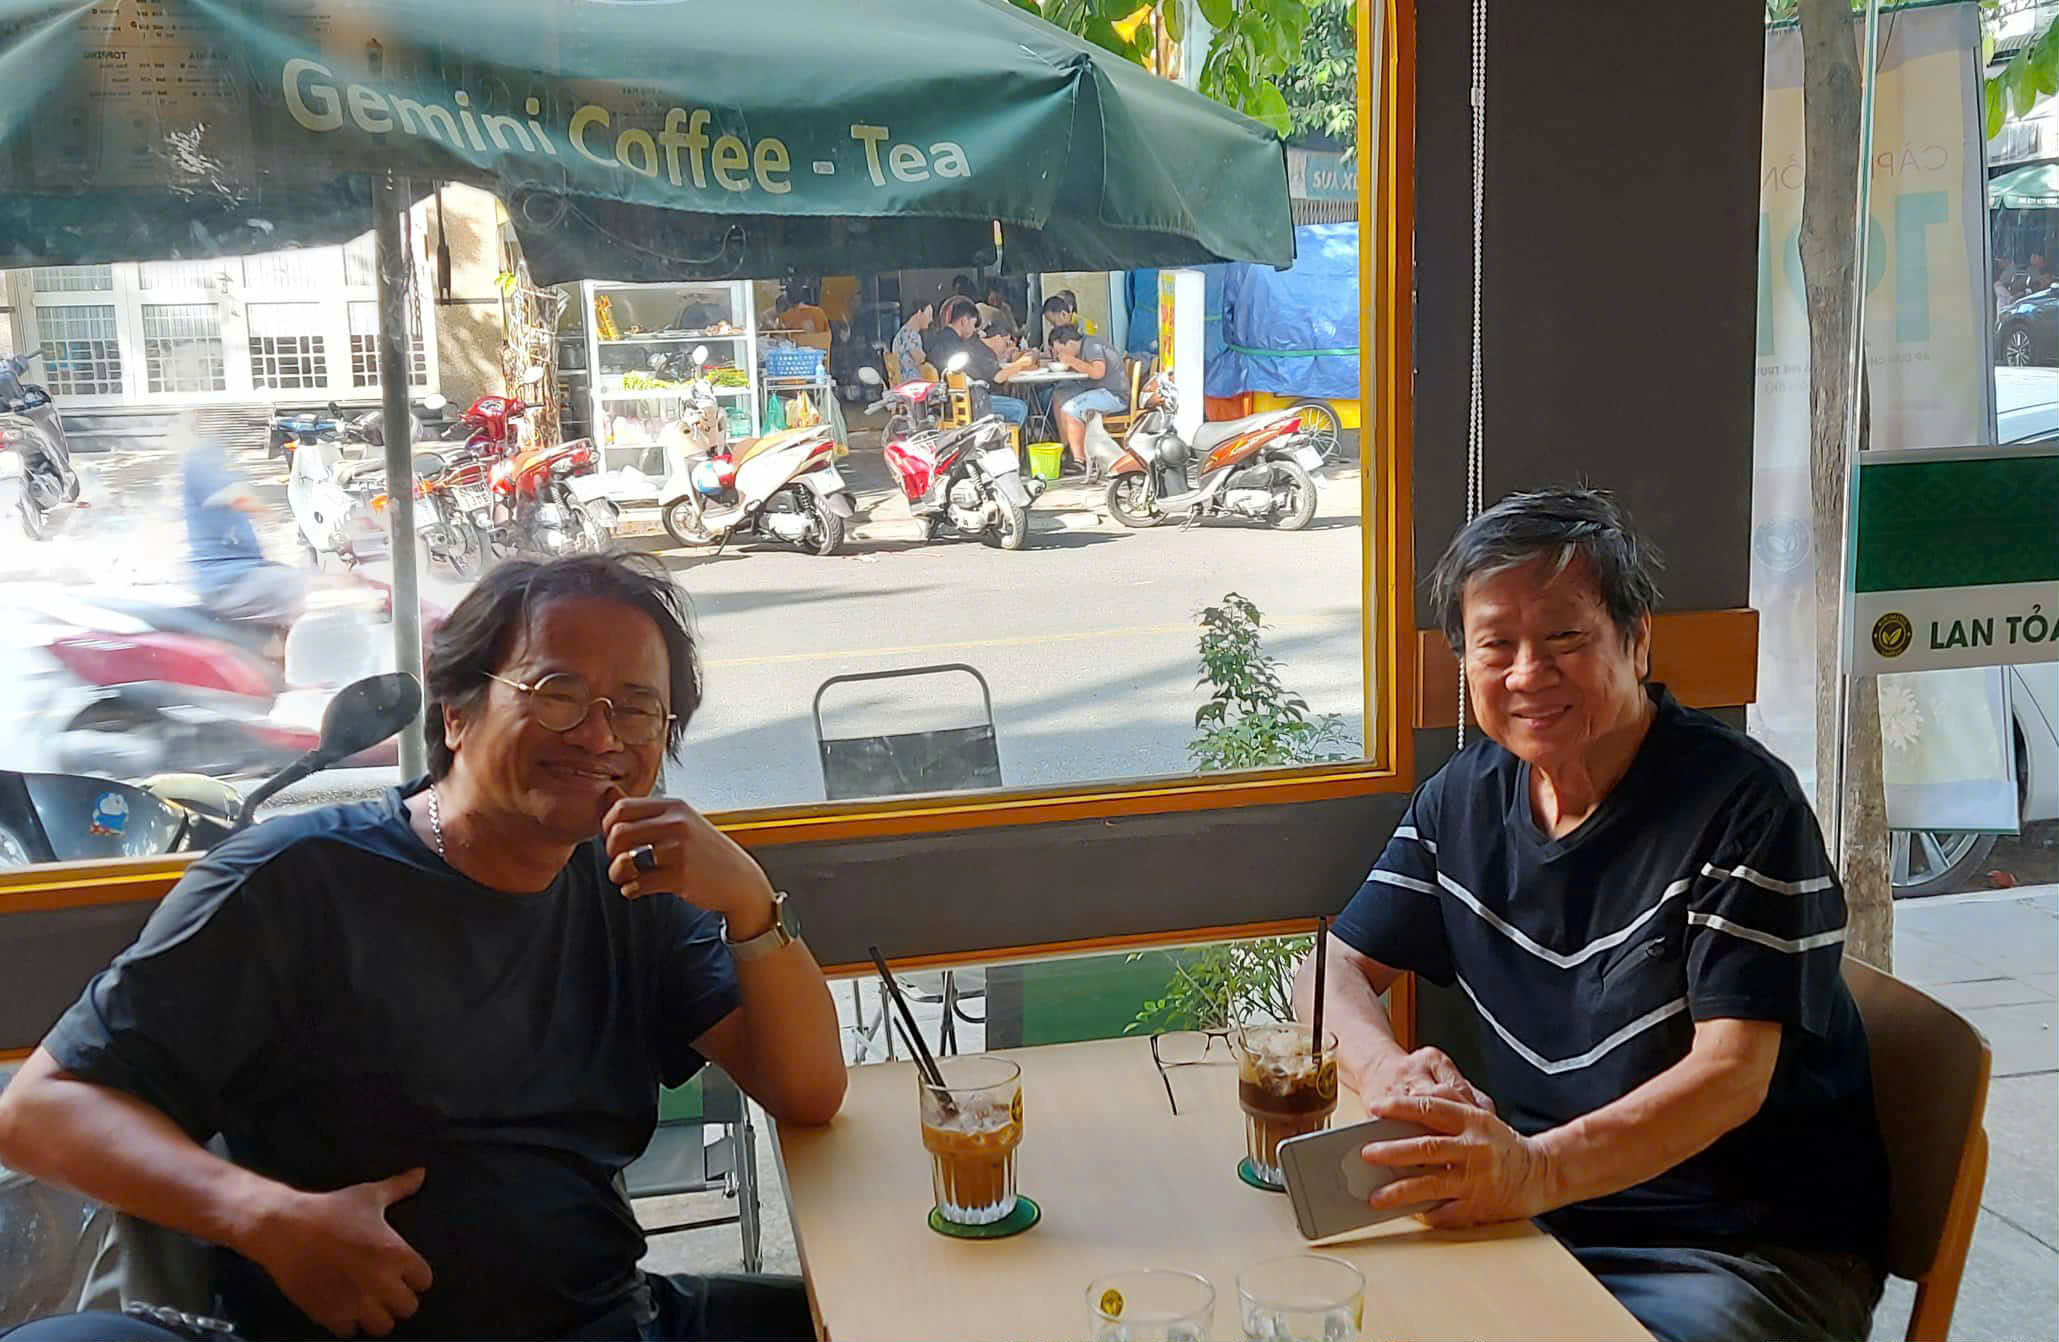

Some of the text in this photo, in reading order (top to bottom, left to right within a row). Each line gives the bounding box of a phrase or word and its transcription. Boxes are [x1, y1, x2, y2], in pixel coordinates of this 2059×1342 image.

[282, 58, 972, 194] Gemini Coffee - Tea
[1930, 618, 1994, 650] LAN
